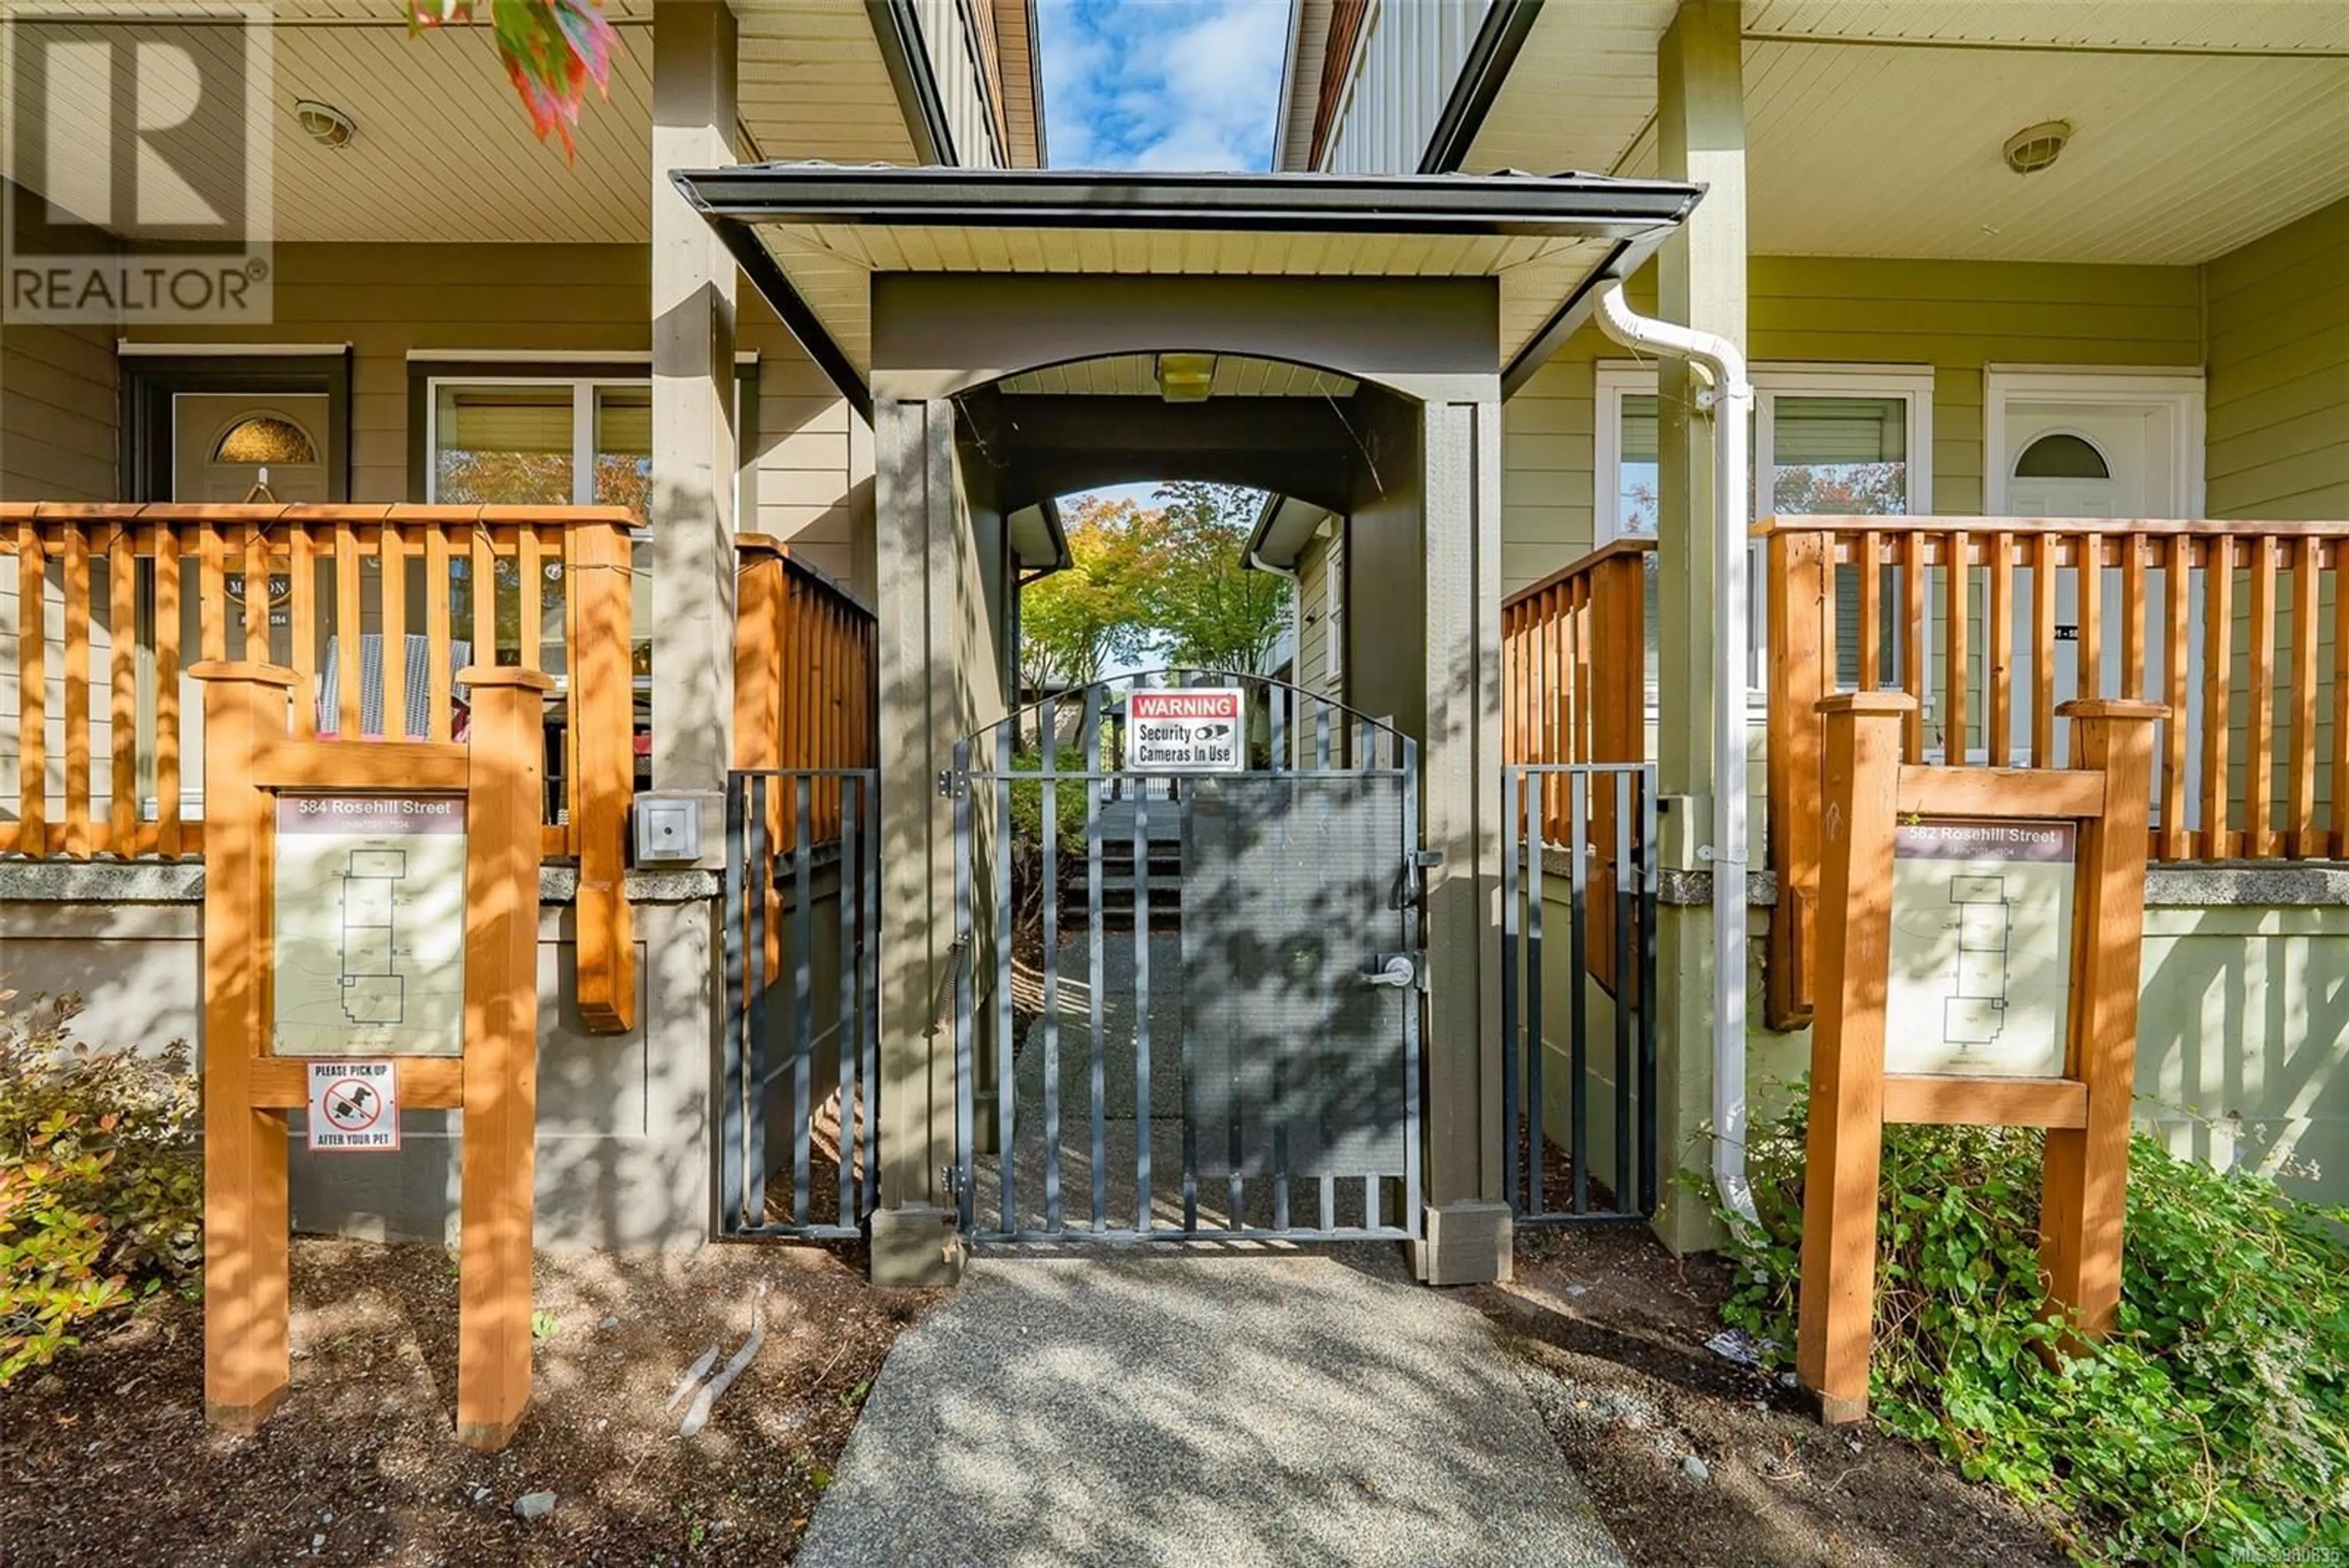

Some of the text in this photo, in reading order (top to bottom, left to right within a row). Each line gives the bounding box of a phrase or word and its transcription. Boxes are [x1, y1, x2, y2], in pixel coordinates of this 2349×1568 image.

[1138, 698, 1231, 716] WARNING
[1139, 724, 1191, 743] Security
[1139, 746, 1230, 762] Cameras In Use
[299, 800, 451, 814] 584 Rosehill Street
[1909, 827, 2056, 843] 582 Rosehill Street
[315, 1065, 387, 1076] PLEASE PICK UP
[317, 1134, 388, 1145] AFTER YOUR PET
